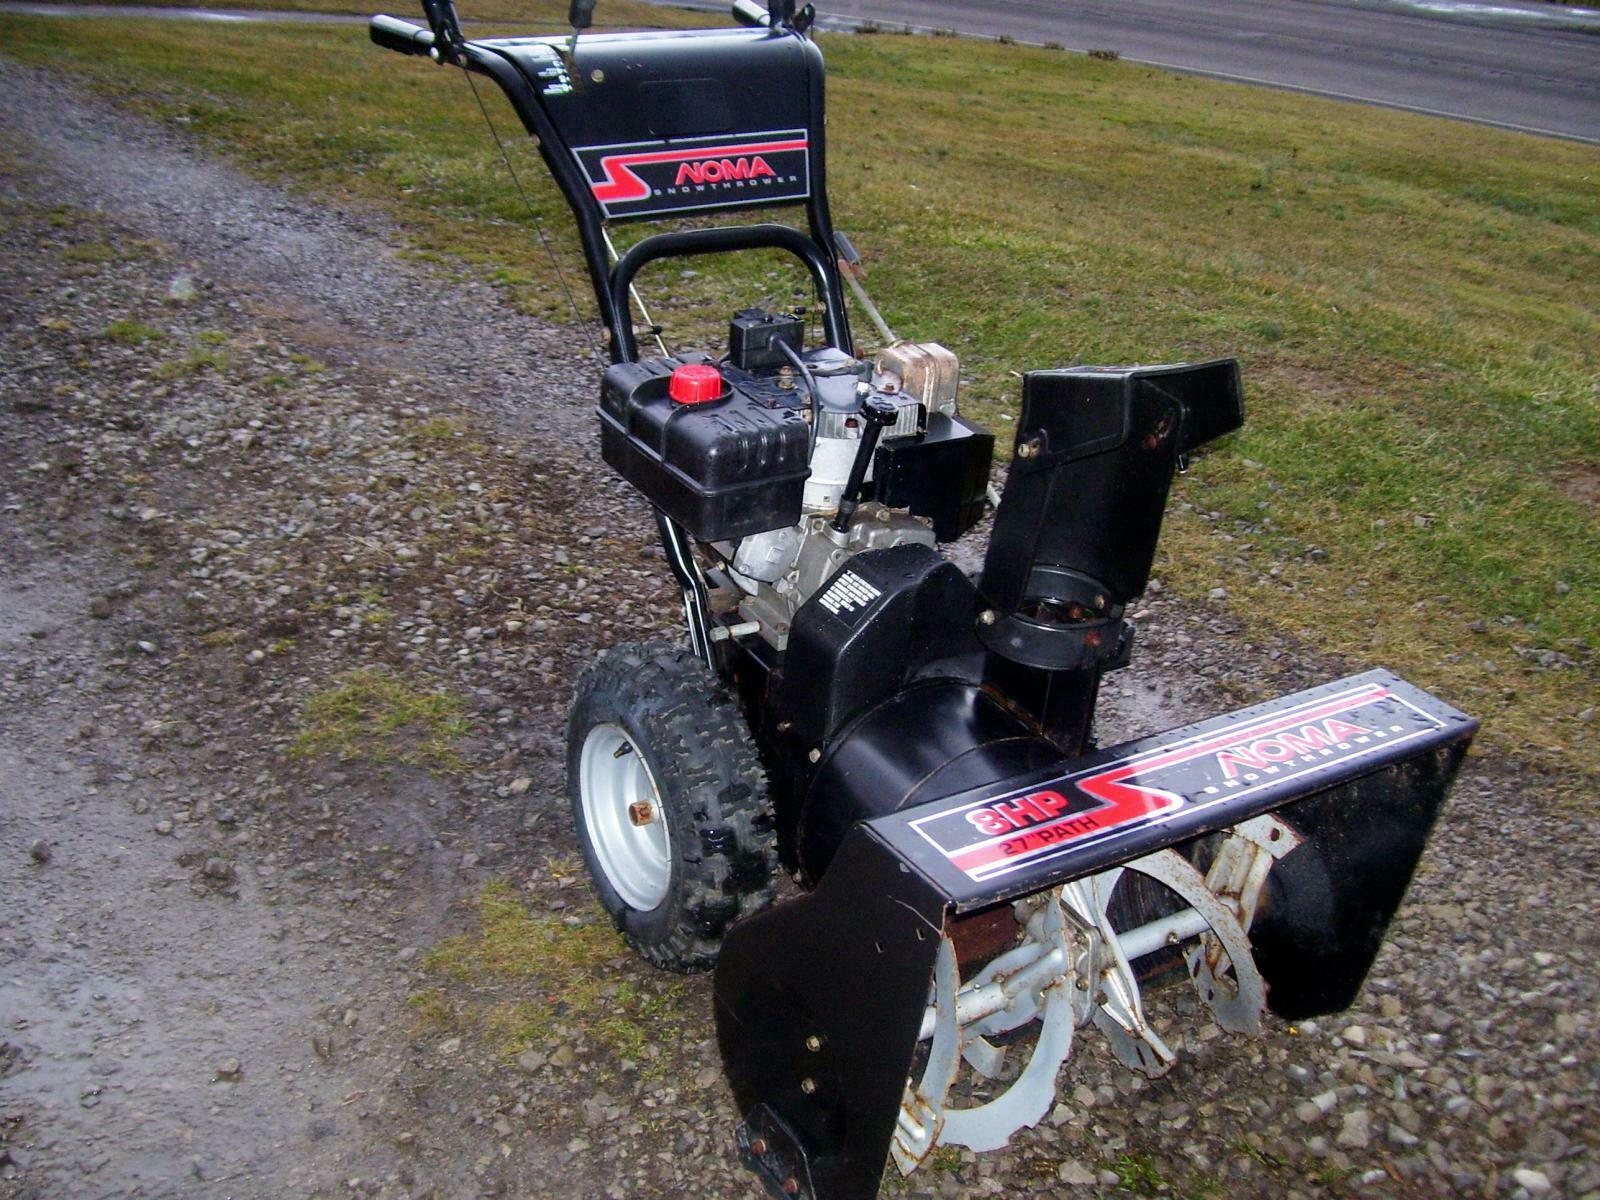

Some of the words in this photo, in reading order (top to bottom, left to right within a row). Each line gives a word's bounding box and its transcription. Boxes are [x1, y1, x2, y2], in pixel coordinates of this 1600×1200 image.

[653, 175, 798, 196] SNOWTHROWER
[675, 156, 776, 186] NOMA
[1203, 725, 1405, 795] SNOWTHROWER
[1215, 718, 1373, 780] NOMA
[965, 790, 1069, 836] 8HP
